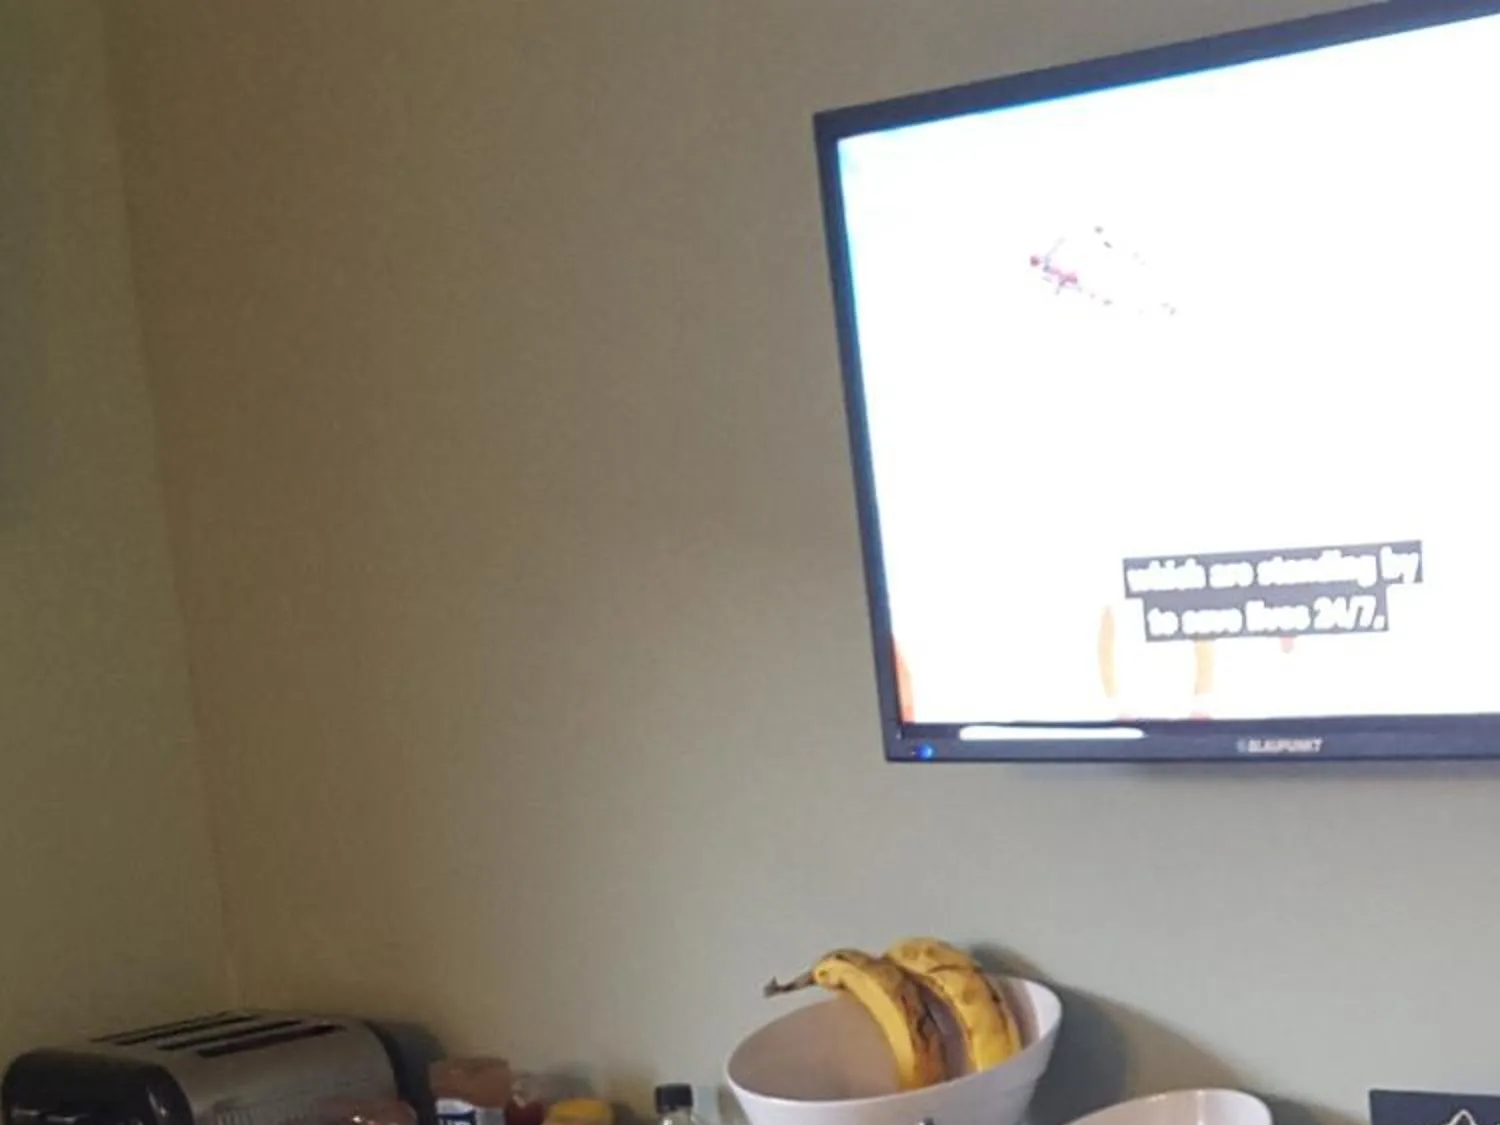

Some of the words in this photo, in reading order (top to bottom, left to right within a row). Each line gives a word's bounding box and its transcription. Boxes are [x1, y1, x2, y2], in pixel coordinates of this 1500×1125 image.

[1255, 548, 1379, 589] standing
[1379, 545, 1420, 585] by
[1146, 607, 1180, 637] to
